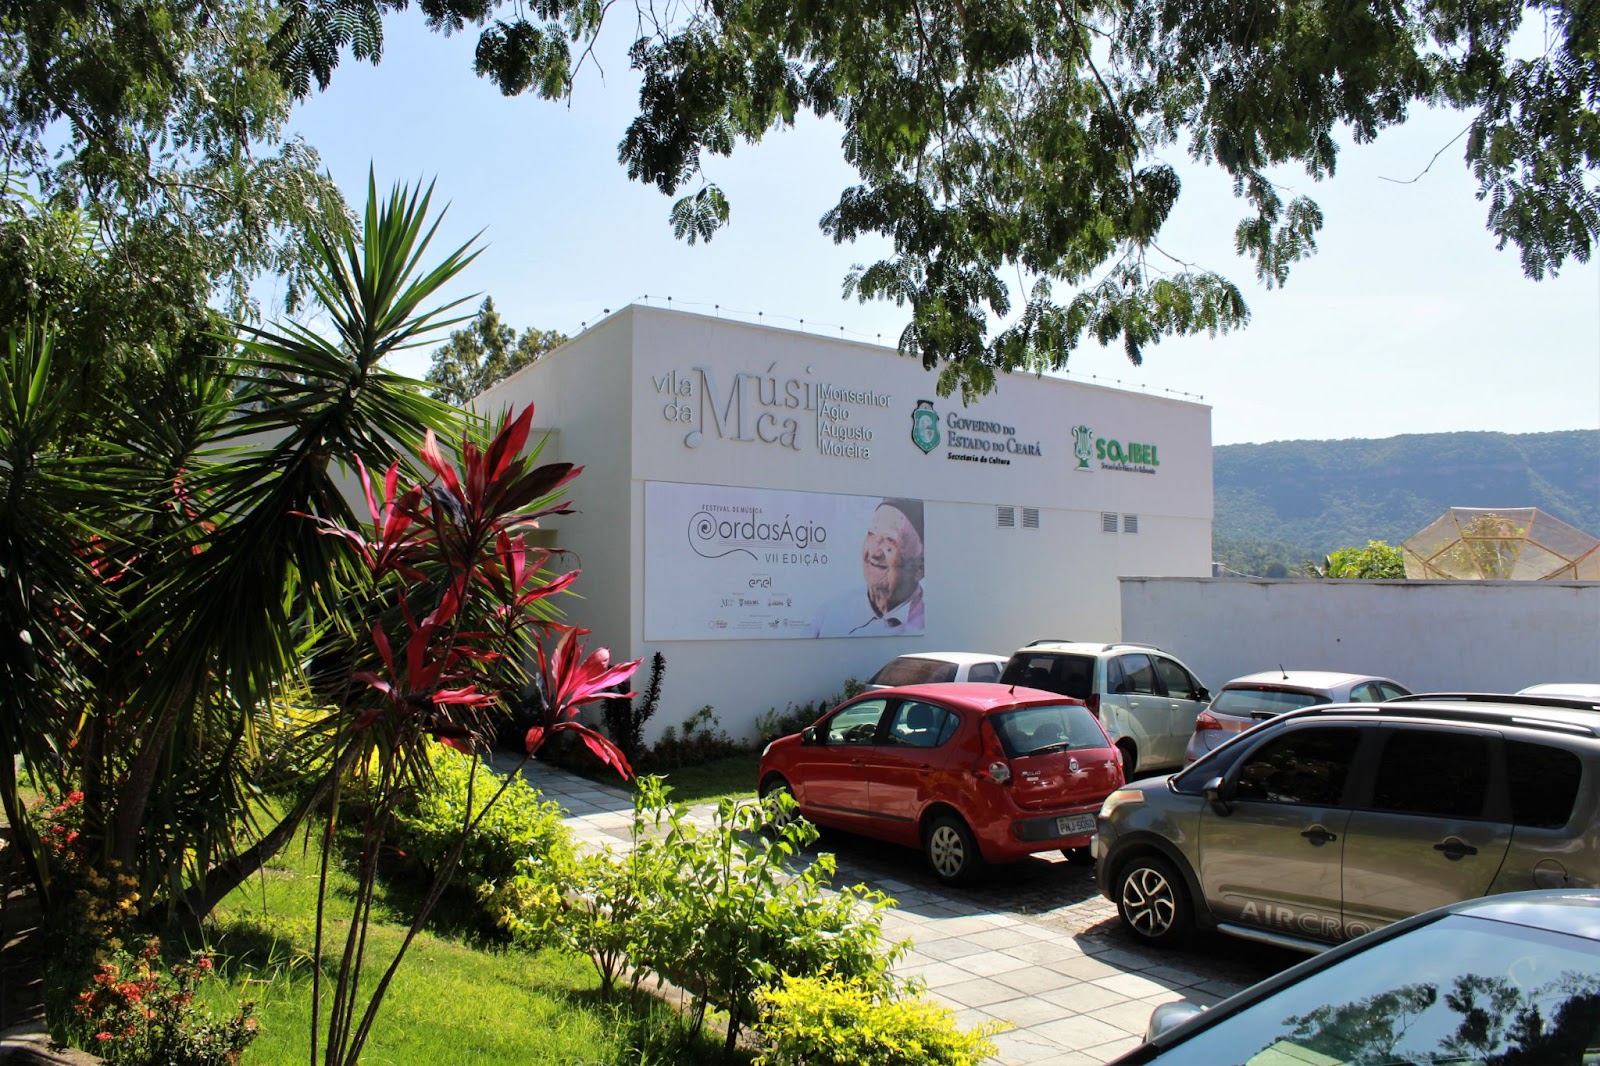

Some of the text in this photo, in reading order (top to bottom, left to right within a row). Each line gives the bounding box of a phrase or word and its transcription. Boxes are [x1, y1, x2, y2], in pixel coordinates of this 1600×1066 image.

[820, 383, 892, 407] Monsenhor
[663, 397, 693, 422] da
[820, 401, 850, 422] Ágio
[756, 412, 801, 451] ca
[820, 421, 874, 442] Augusto
[820, 439, 870, 460] Moreira
[947, 452, 979, 462] Secretaria
[988, 457, 1011, 466] Cultura
[702, 504, 730, 513] FESTIVAL
[740, 505, 763, 514] MÚSICA
[765, 552, 828, 567] VII EDIÇÃO
[748, 576, 772, 588] enel
[1239, 901, 1385, 940] AIRCRO
